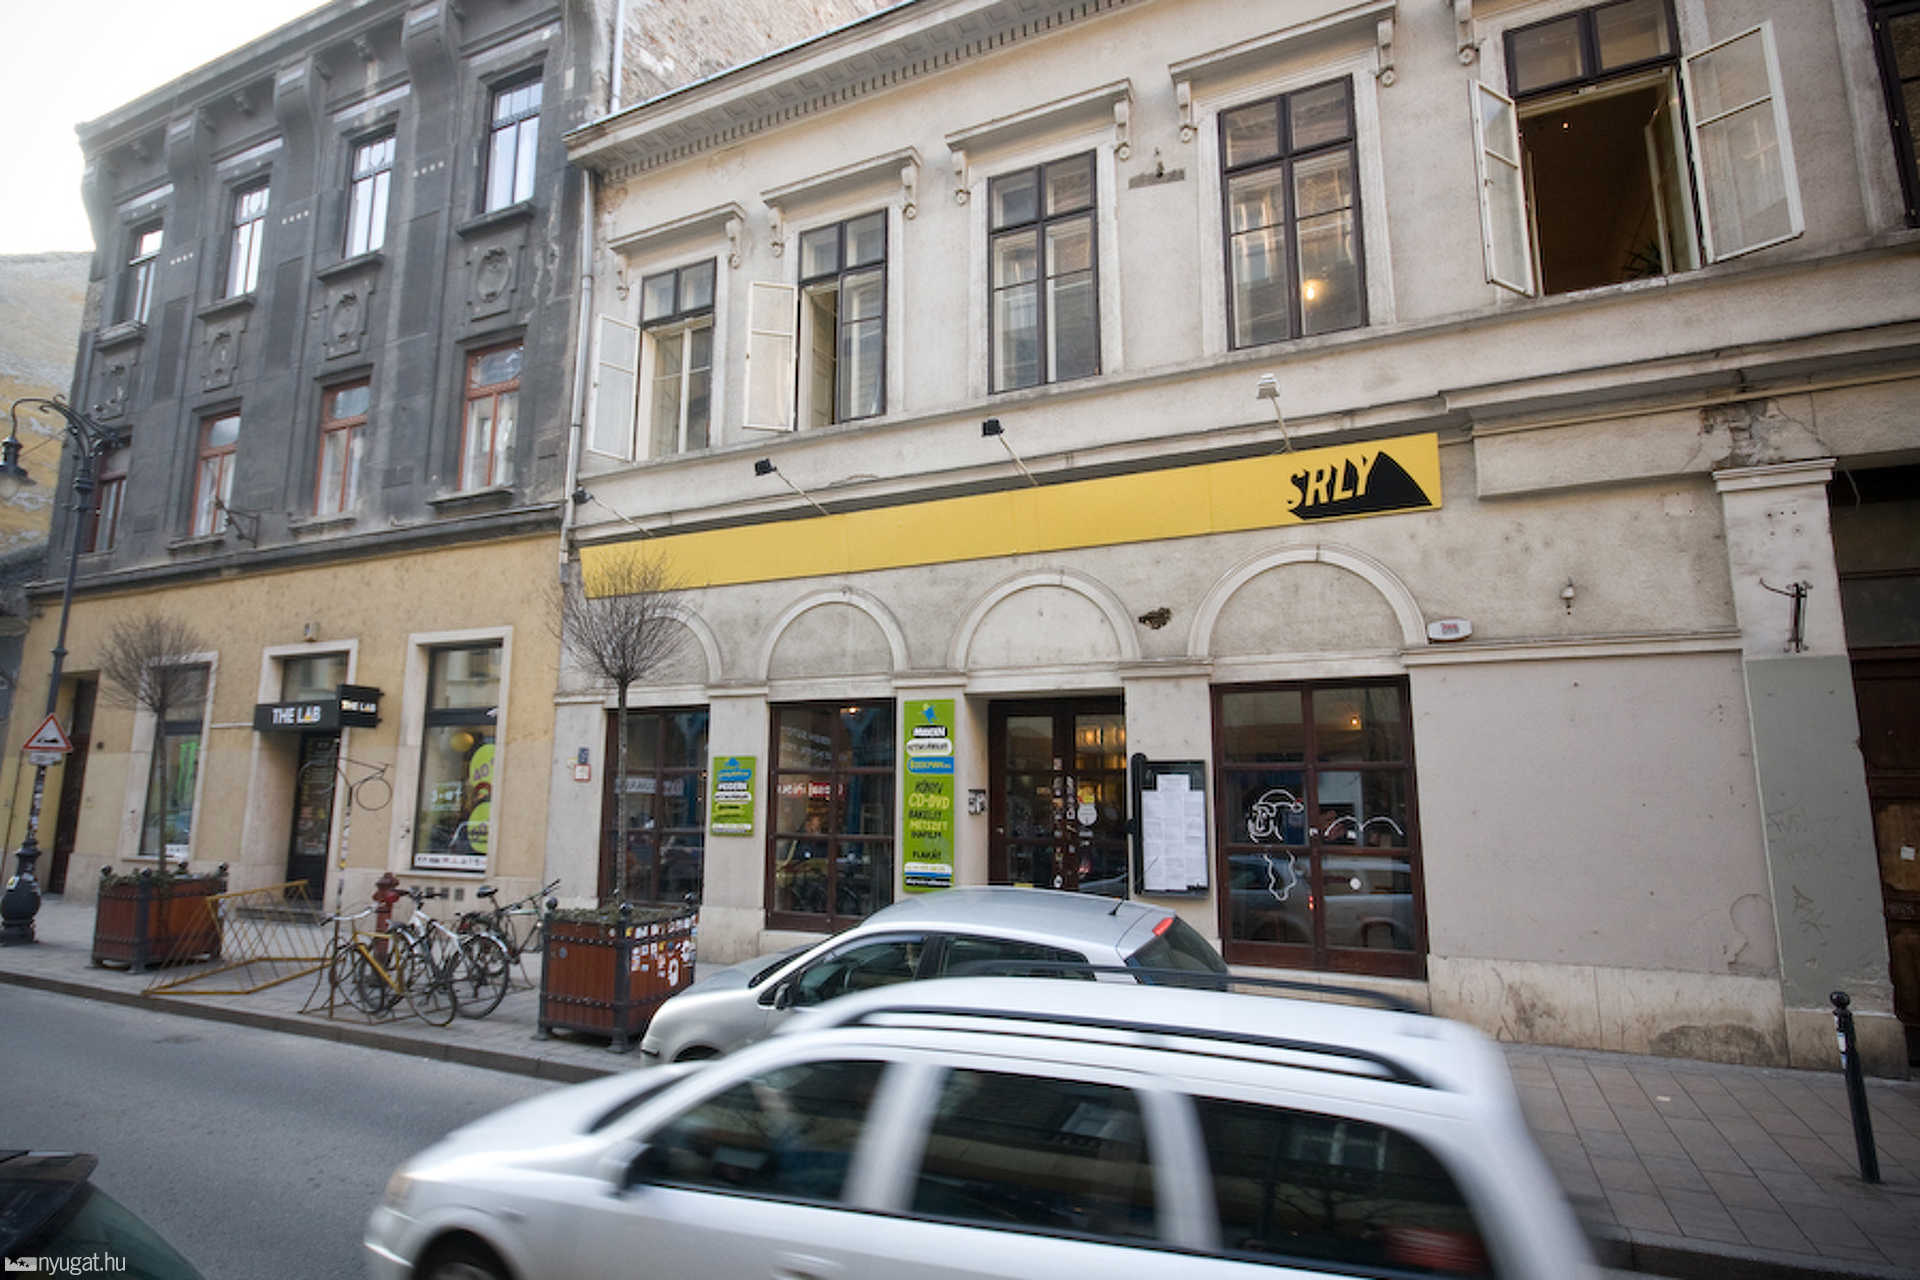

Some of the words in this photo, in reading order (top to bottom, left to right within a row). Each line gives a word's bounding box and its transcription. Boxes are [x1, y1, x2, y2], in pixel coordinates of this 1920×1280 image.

[1286, 450, 1381, 513] SRLY
[272, 707, 296, 724] THE
[297, 705, 321, 723] LAB
[341, 699, 359, 711] THE
[360, 701, 377, 713] LAB
[907, 793, 950, 809] CD-DVD
